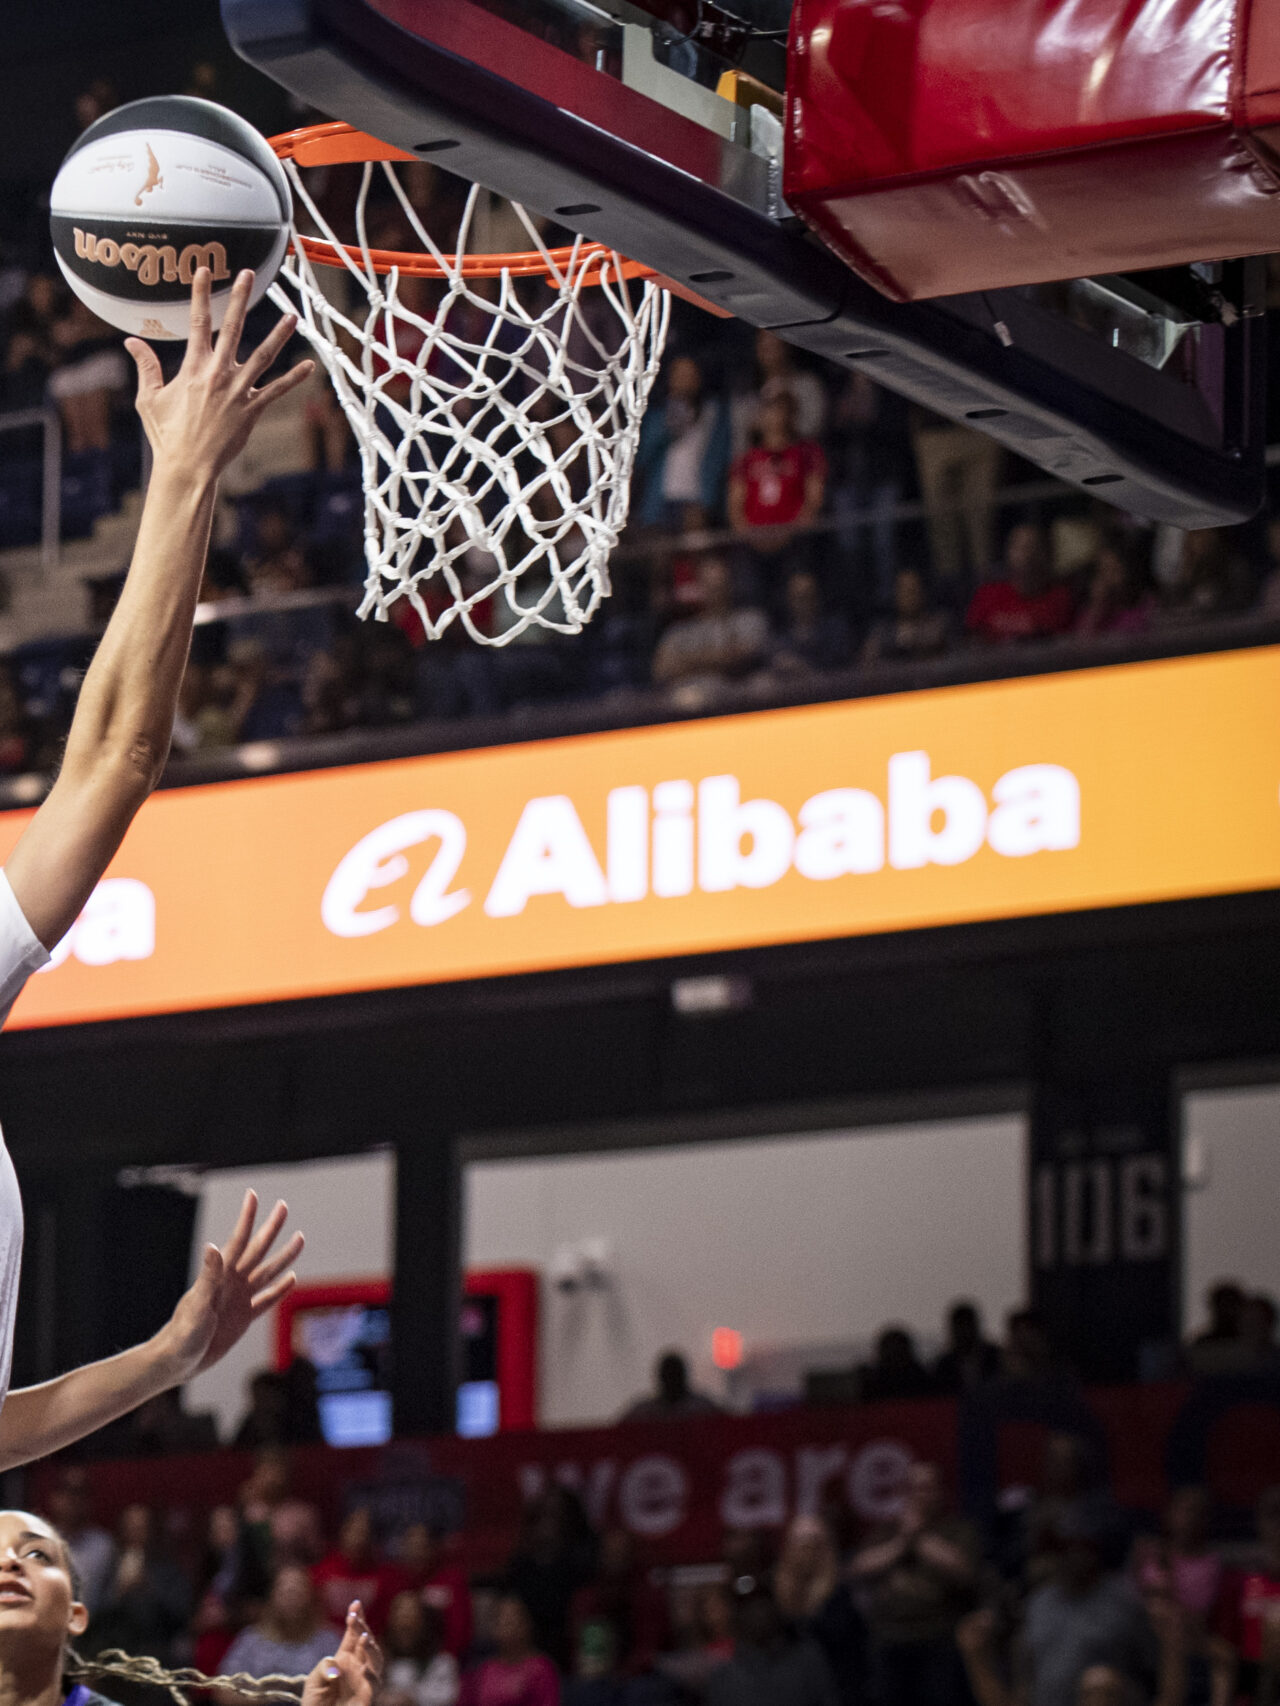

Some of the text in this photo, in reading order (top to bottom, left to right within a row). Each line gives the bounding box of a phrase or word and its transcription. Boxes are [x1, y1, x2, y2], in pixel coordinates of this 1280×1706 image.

[73, 227, 231, 286] Wilson
[484, 749, 1081, 918] Alibaba
[1037, 1155, 1166, 1267] 106
[720, 1436, 914, 1530] are
